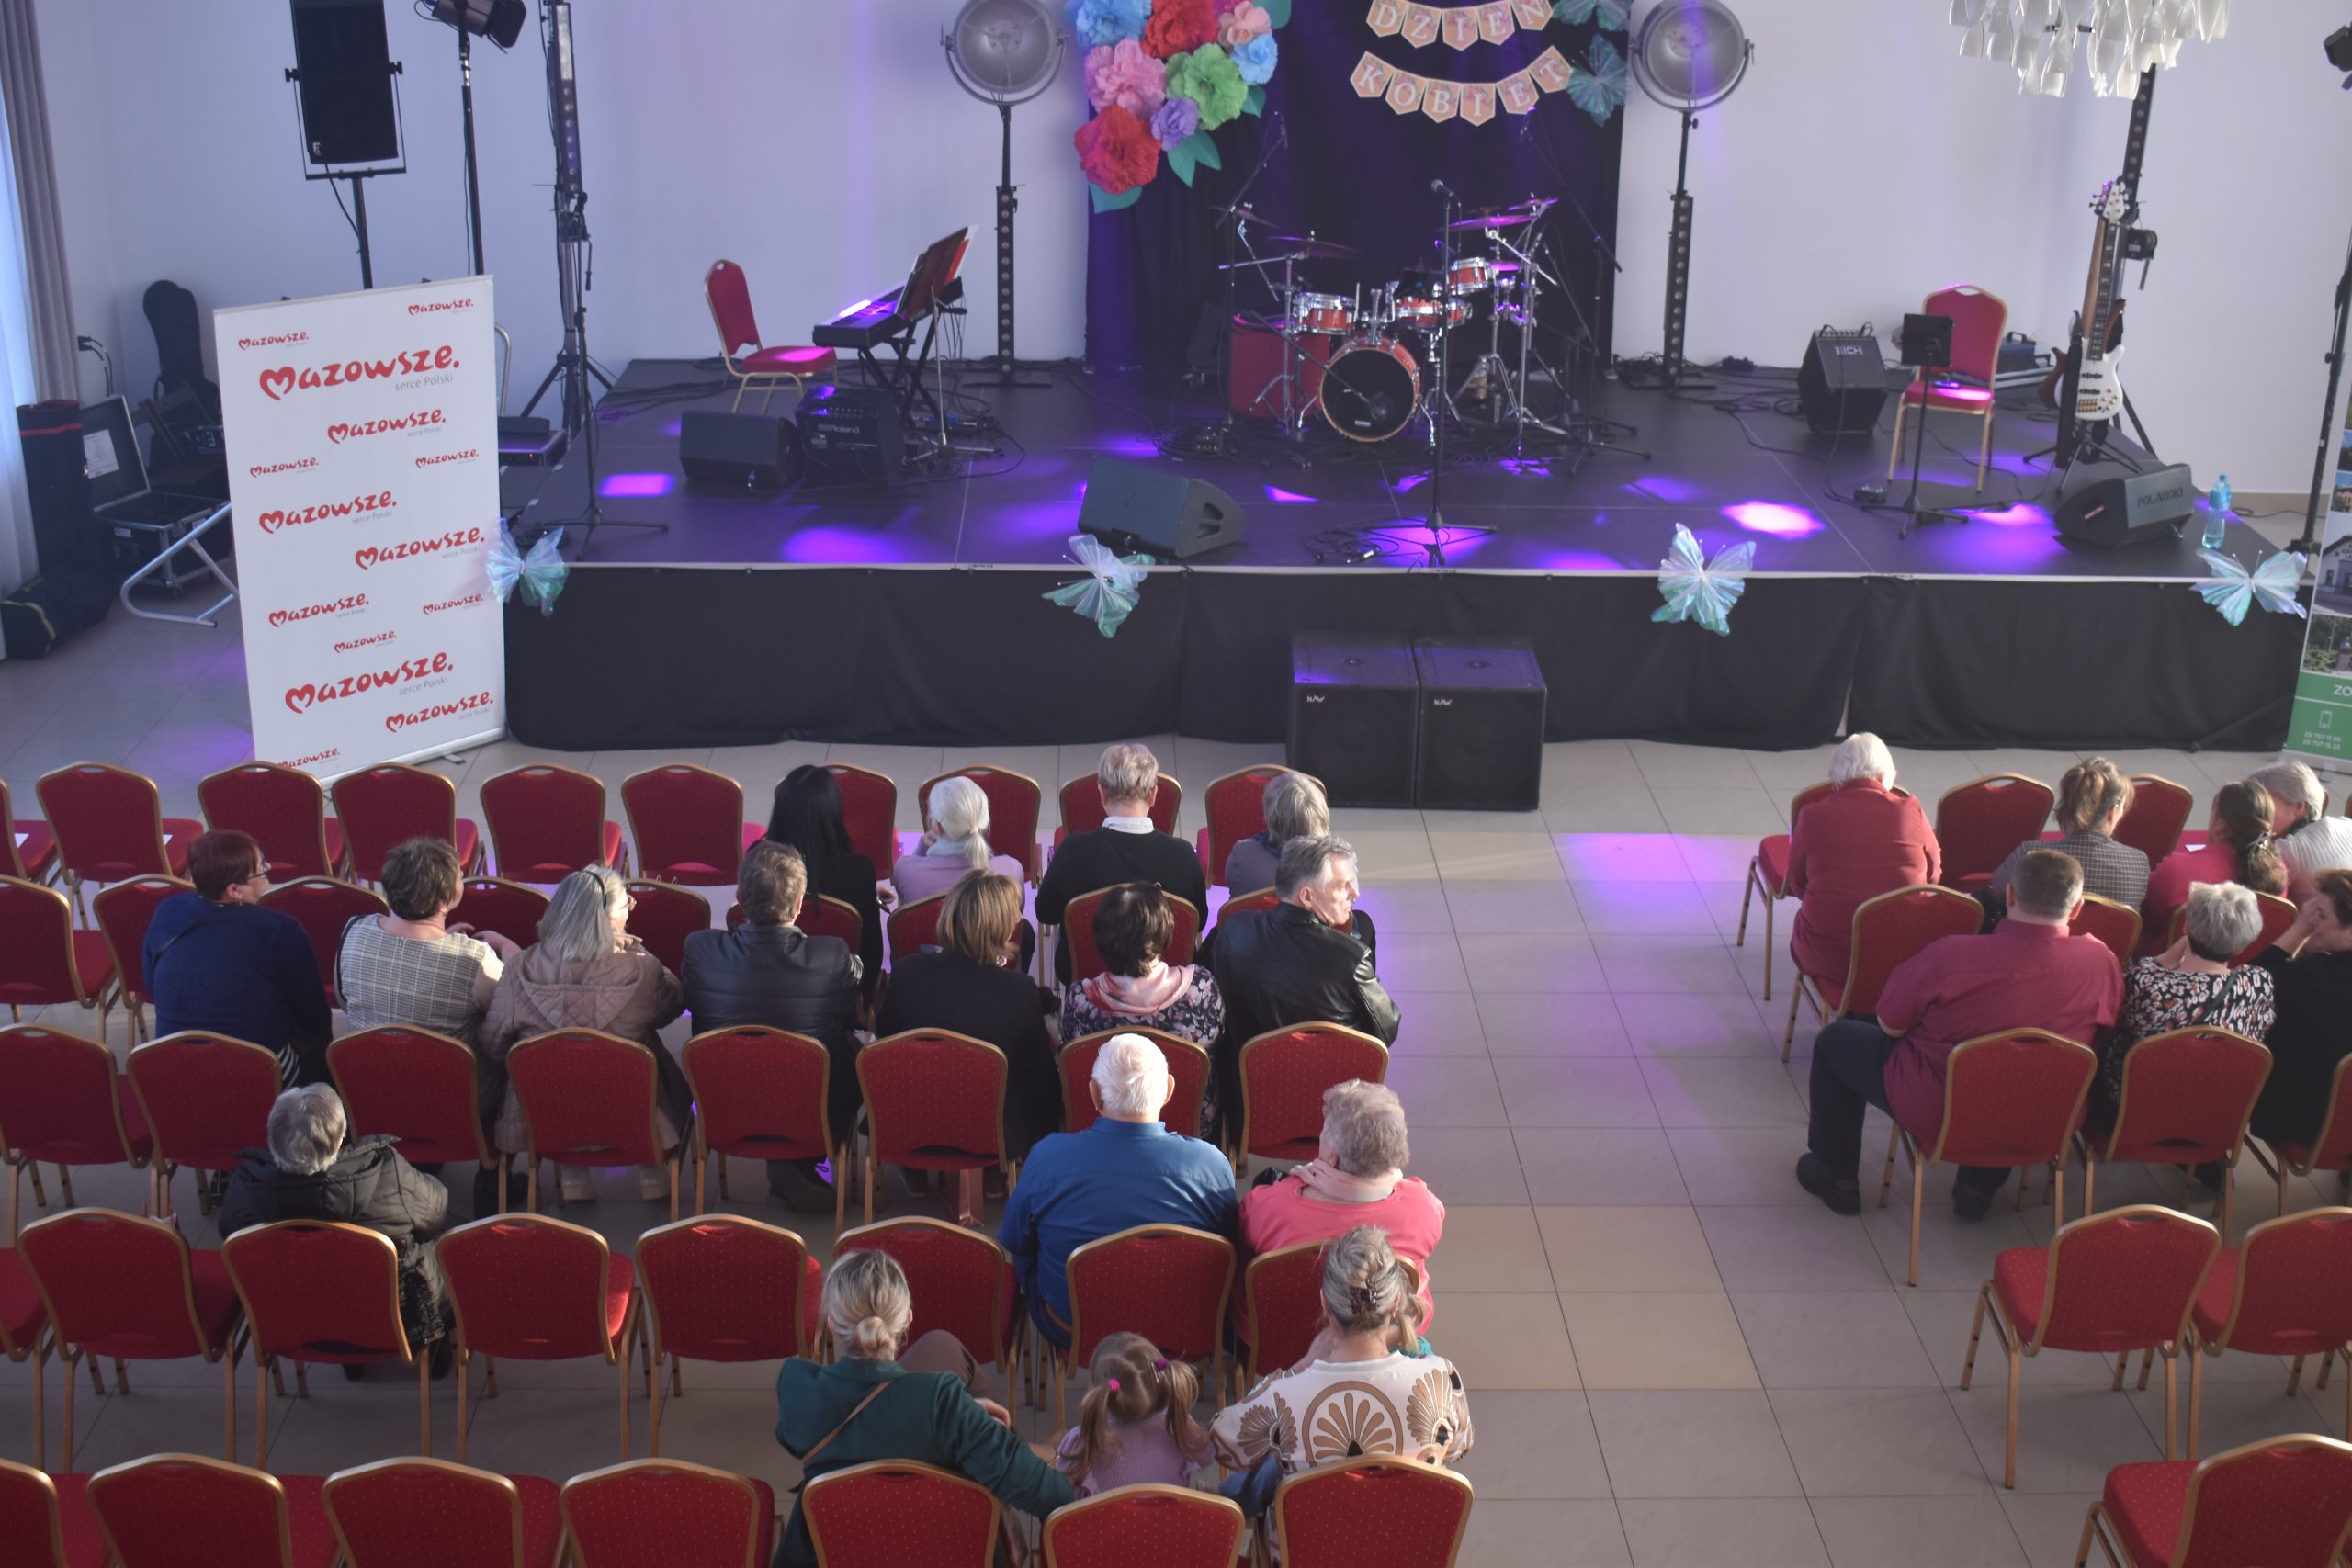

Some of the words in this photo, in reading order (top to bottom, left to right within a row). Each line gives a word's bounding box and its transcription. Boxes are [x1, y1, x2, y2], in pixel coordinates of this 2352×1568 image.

[1358, 60, 1562, 117] KOBIET
[395, 379, 421, 390] serce
[424, 373, 453, 386] Polski
